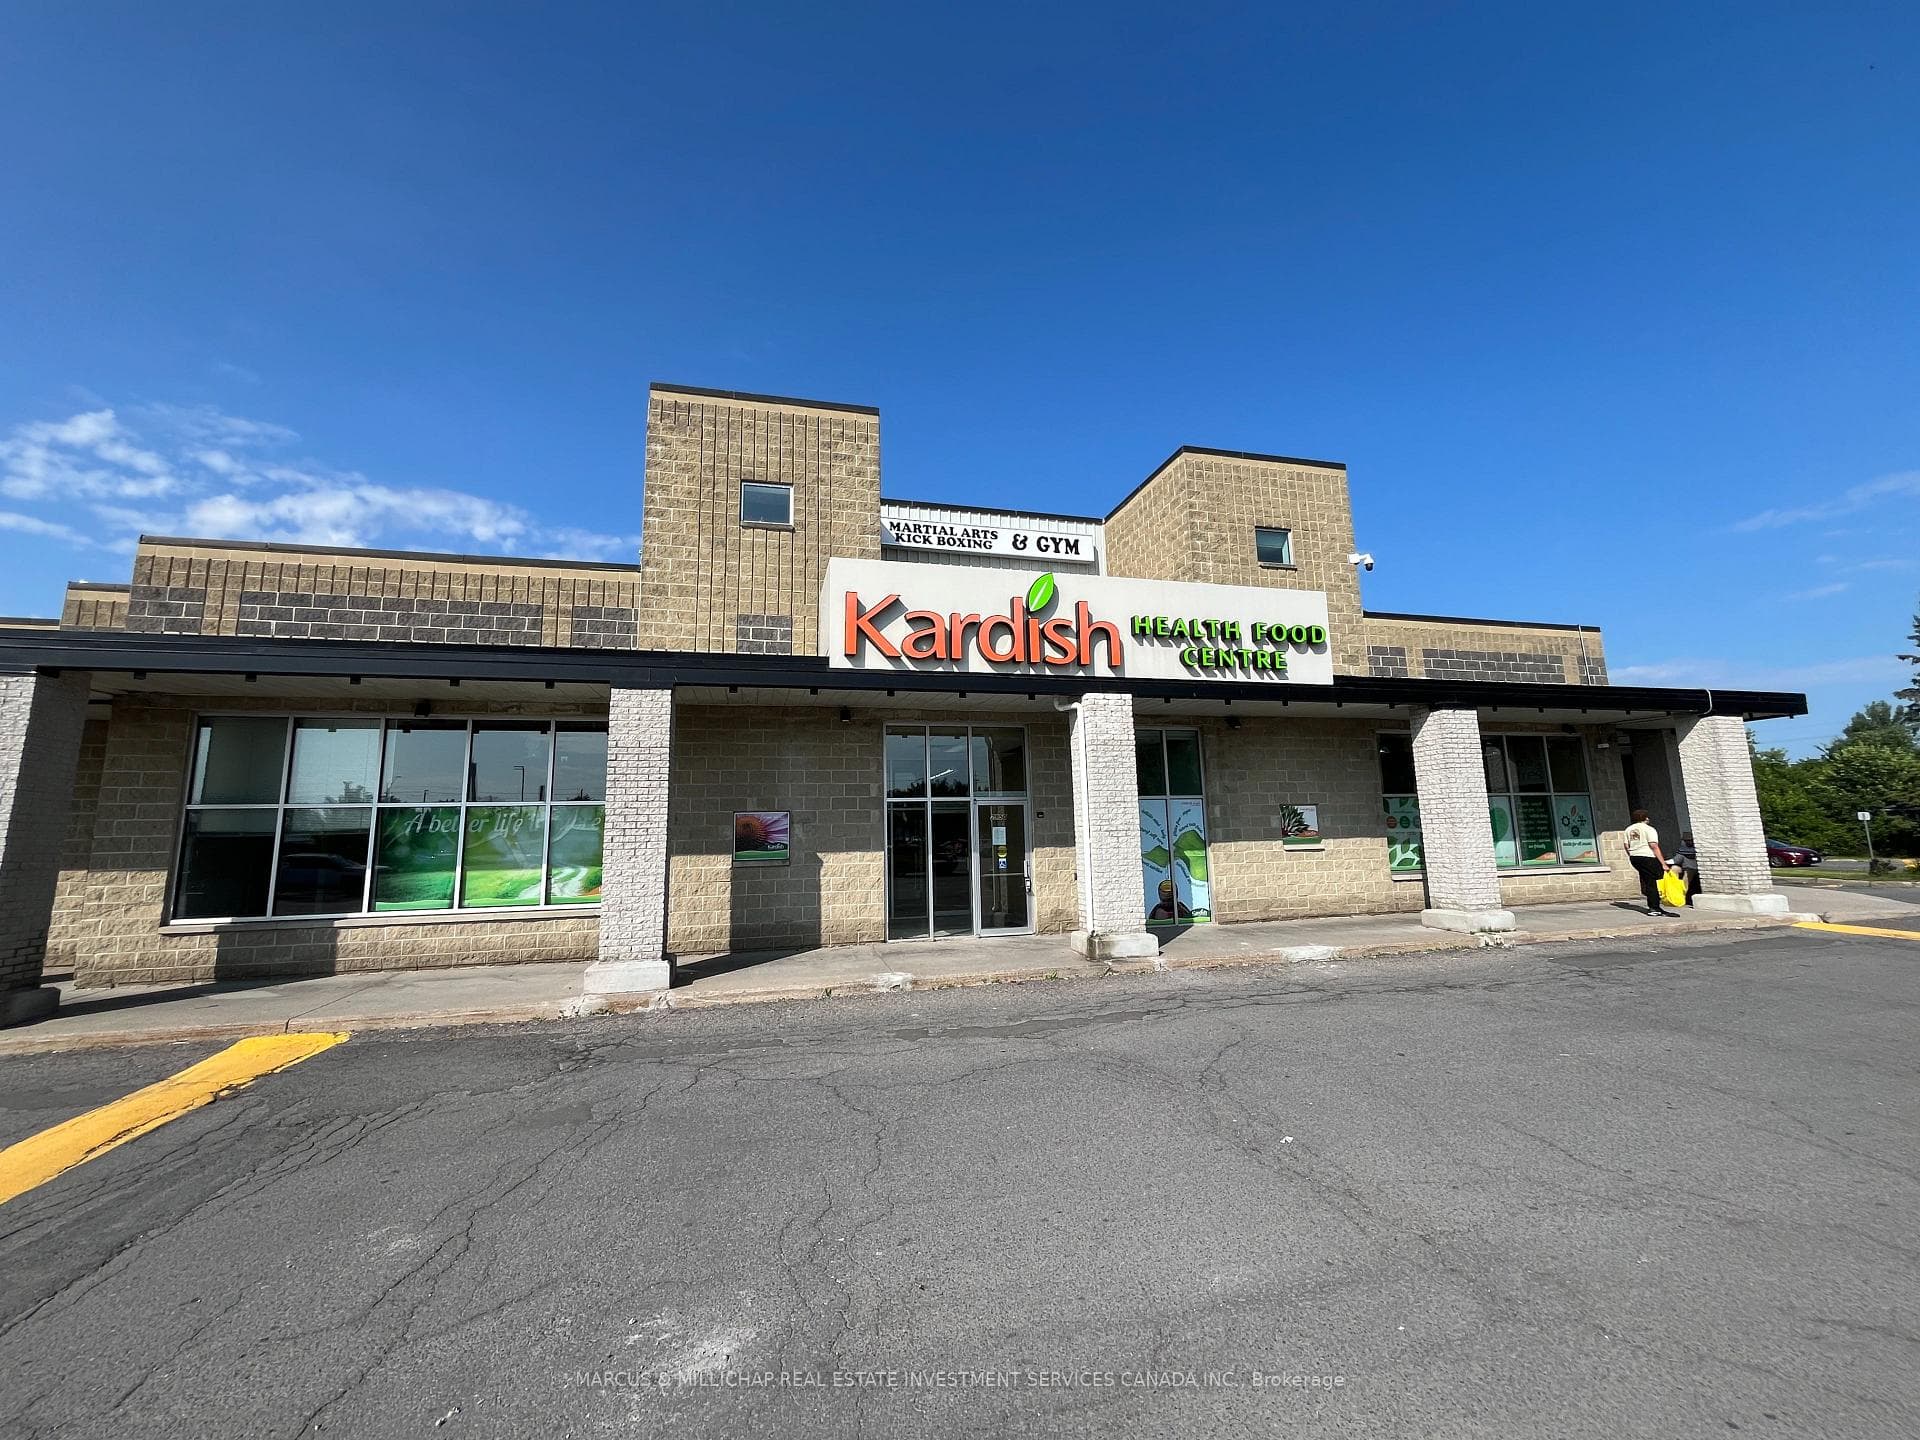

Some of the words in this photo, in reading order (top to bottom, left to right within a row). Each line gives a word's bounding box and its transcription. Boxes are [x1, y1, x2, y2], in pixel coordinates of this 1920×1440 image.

[889, 521, 957, 537] MARTIAL
[961, 527, 999, 540] ARTS
[1012, 533, 1028, 551] &
[1036, 536, 1080, 555] GYM
[895, 532, 932, 545] KICK
[936, 537, 993, 550] BOXING
[844, 590, 1121, 667] Kardish
[1131, 615, 1241, 640] HEALTH
[1251, 622, 1327, 645] FOOD
[1180, 647, 1288, 670] CENTRE
[404, 808, 427, 836] A
[429, 814, 489, 833] beter
[494, 811, 523, 838] life
